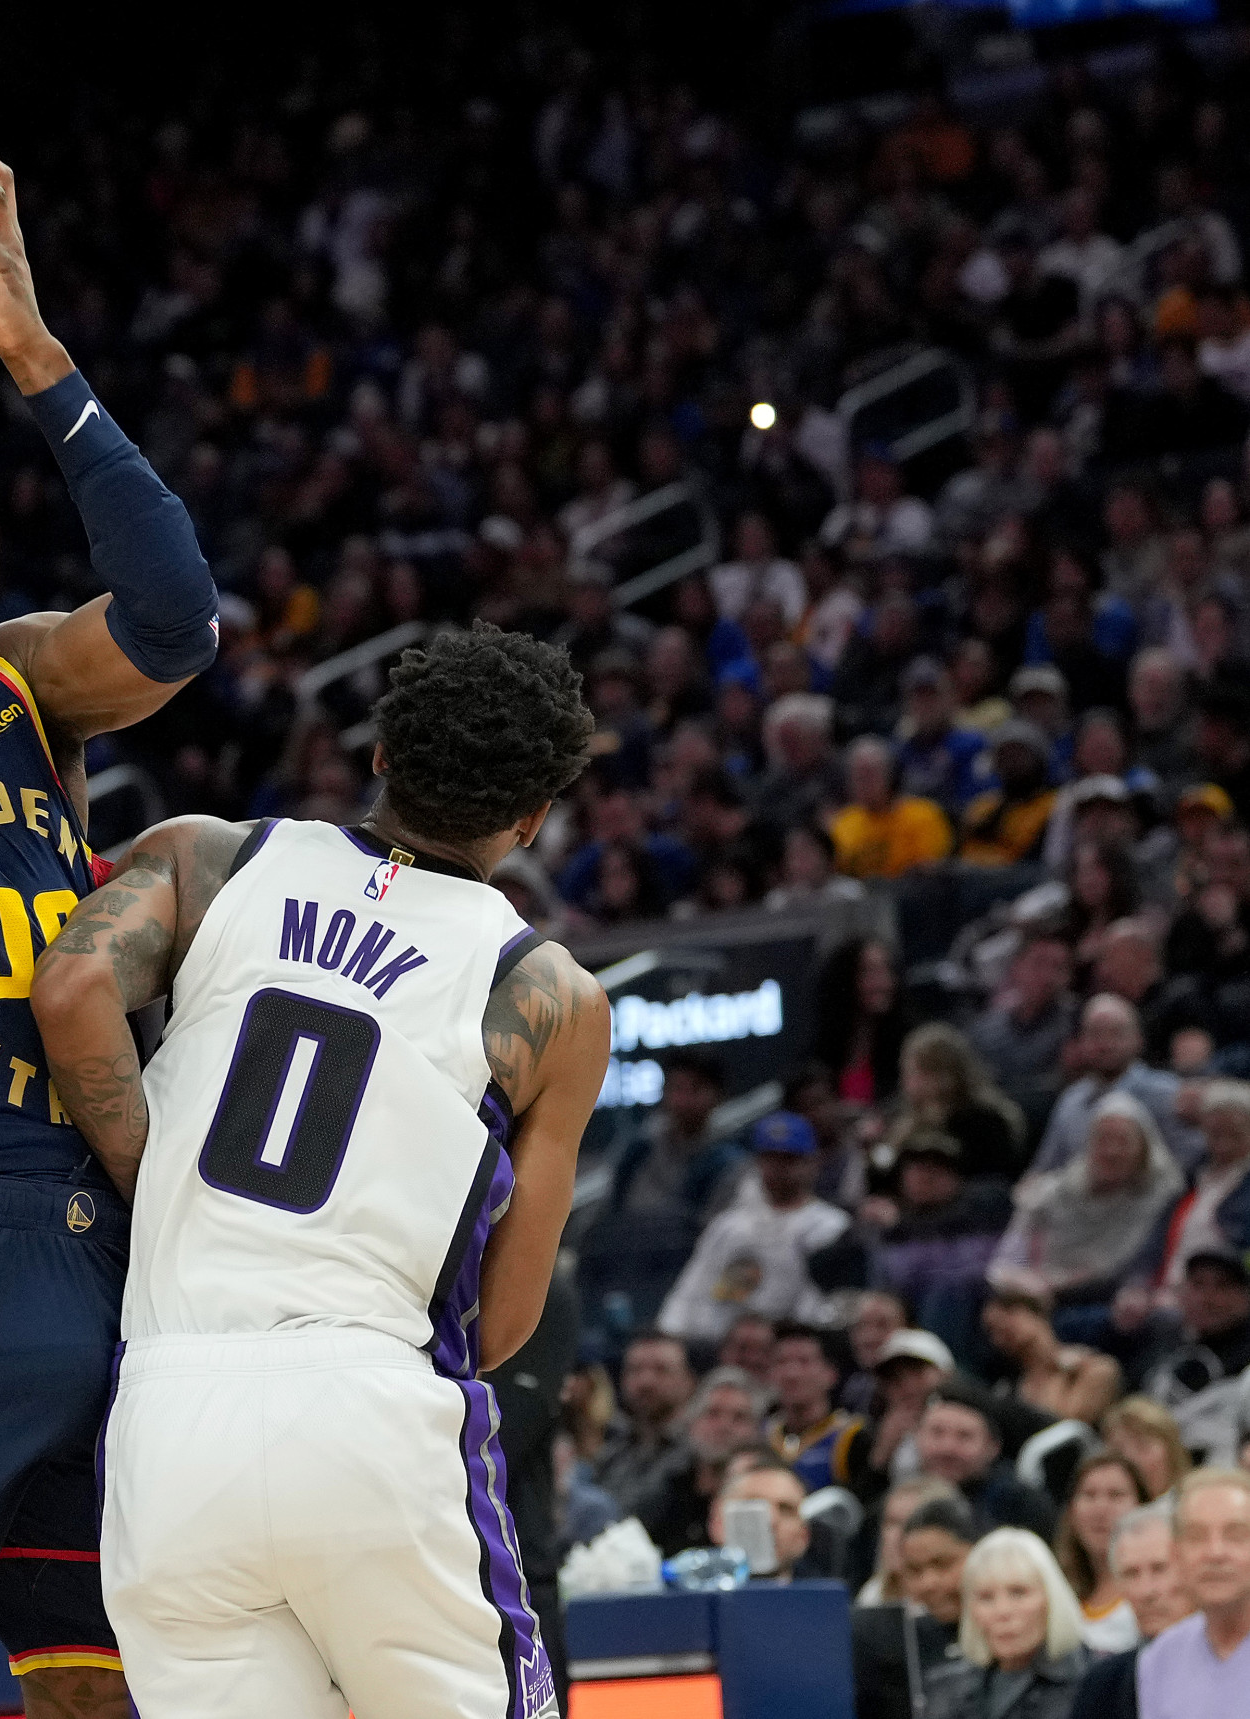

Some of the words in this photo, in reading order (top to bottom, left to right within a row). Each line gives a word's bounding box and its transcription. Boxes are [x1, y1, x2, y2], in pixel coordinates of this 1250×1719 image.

[279, 897, 430, 1001] MONK
[616, 979, 783, 1052] Packard
[198, 987, 382, 1215] 0
